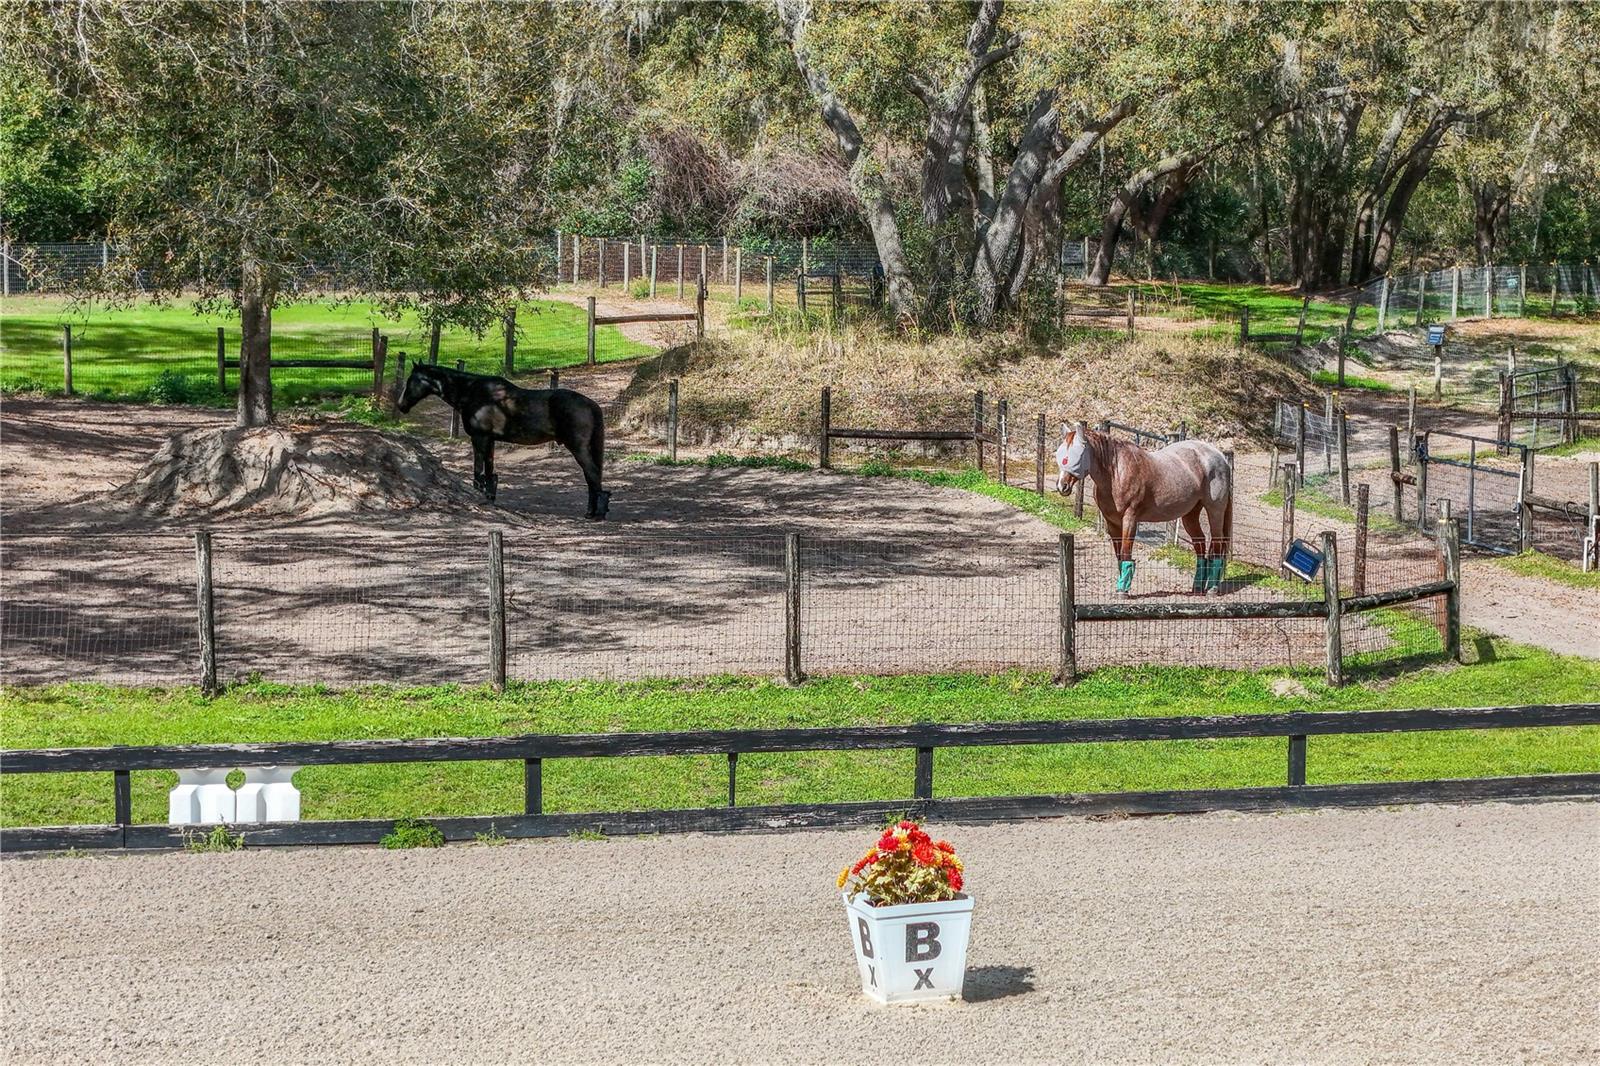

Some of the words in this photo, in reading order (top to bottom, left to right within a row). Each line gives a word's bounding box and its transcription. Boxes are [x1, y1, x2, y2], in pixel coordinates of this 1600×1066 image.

[858, 917, 874, 959] B
[906, 922, 941, 962] B
[868, 964, 877, 987] X
[913, 967, 935, 990] X
